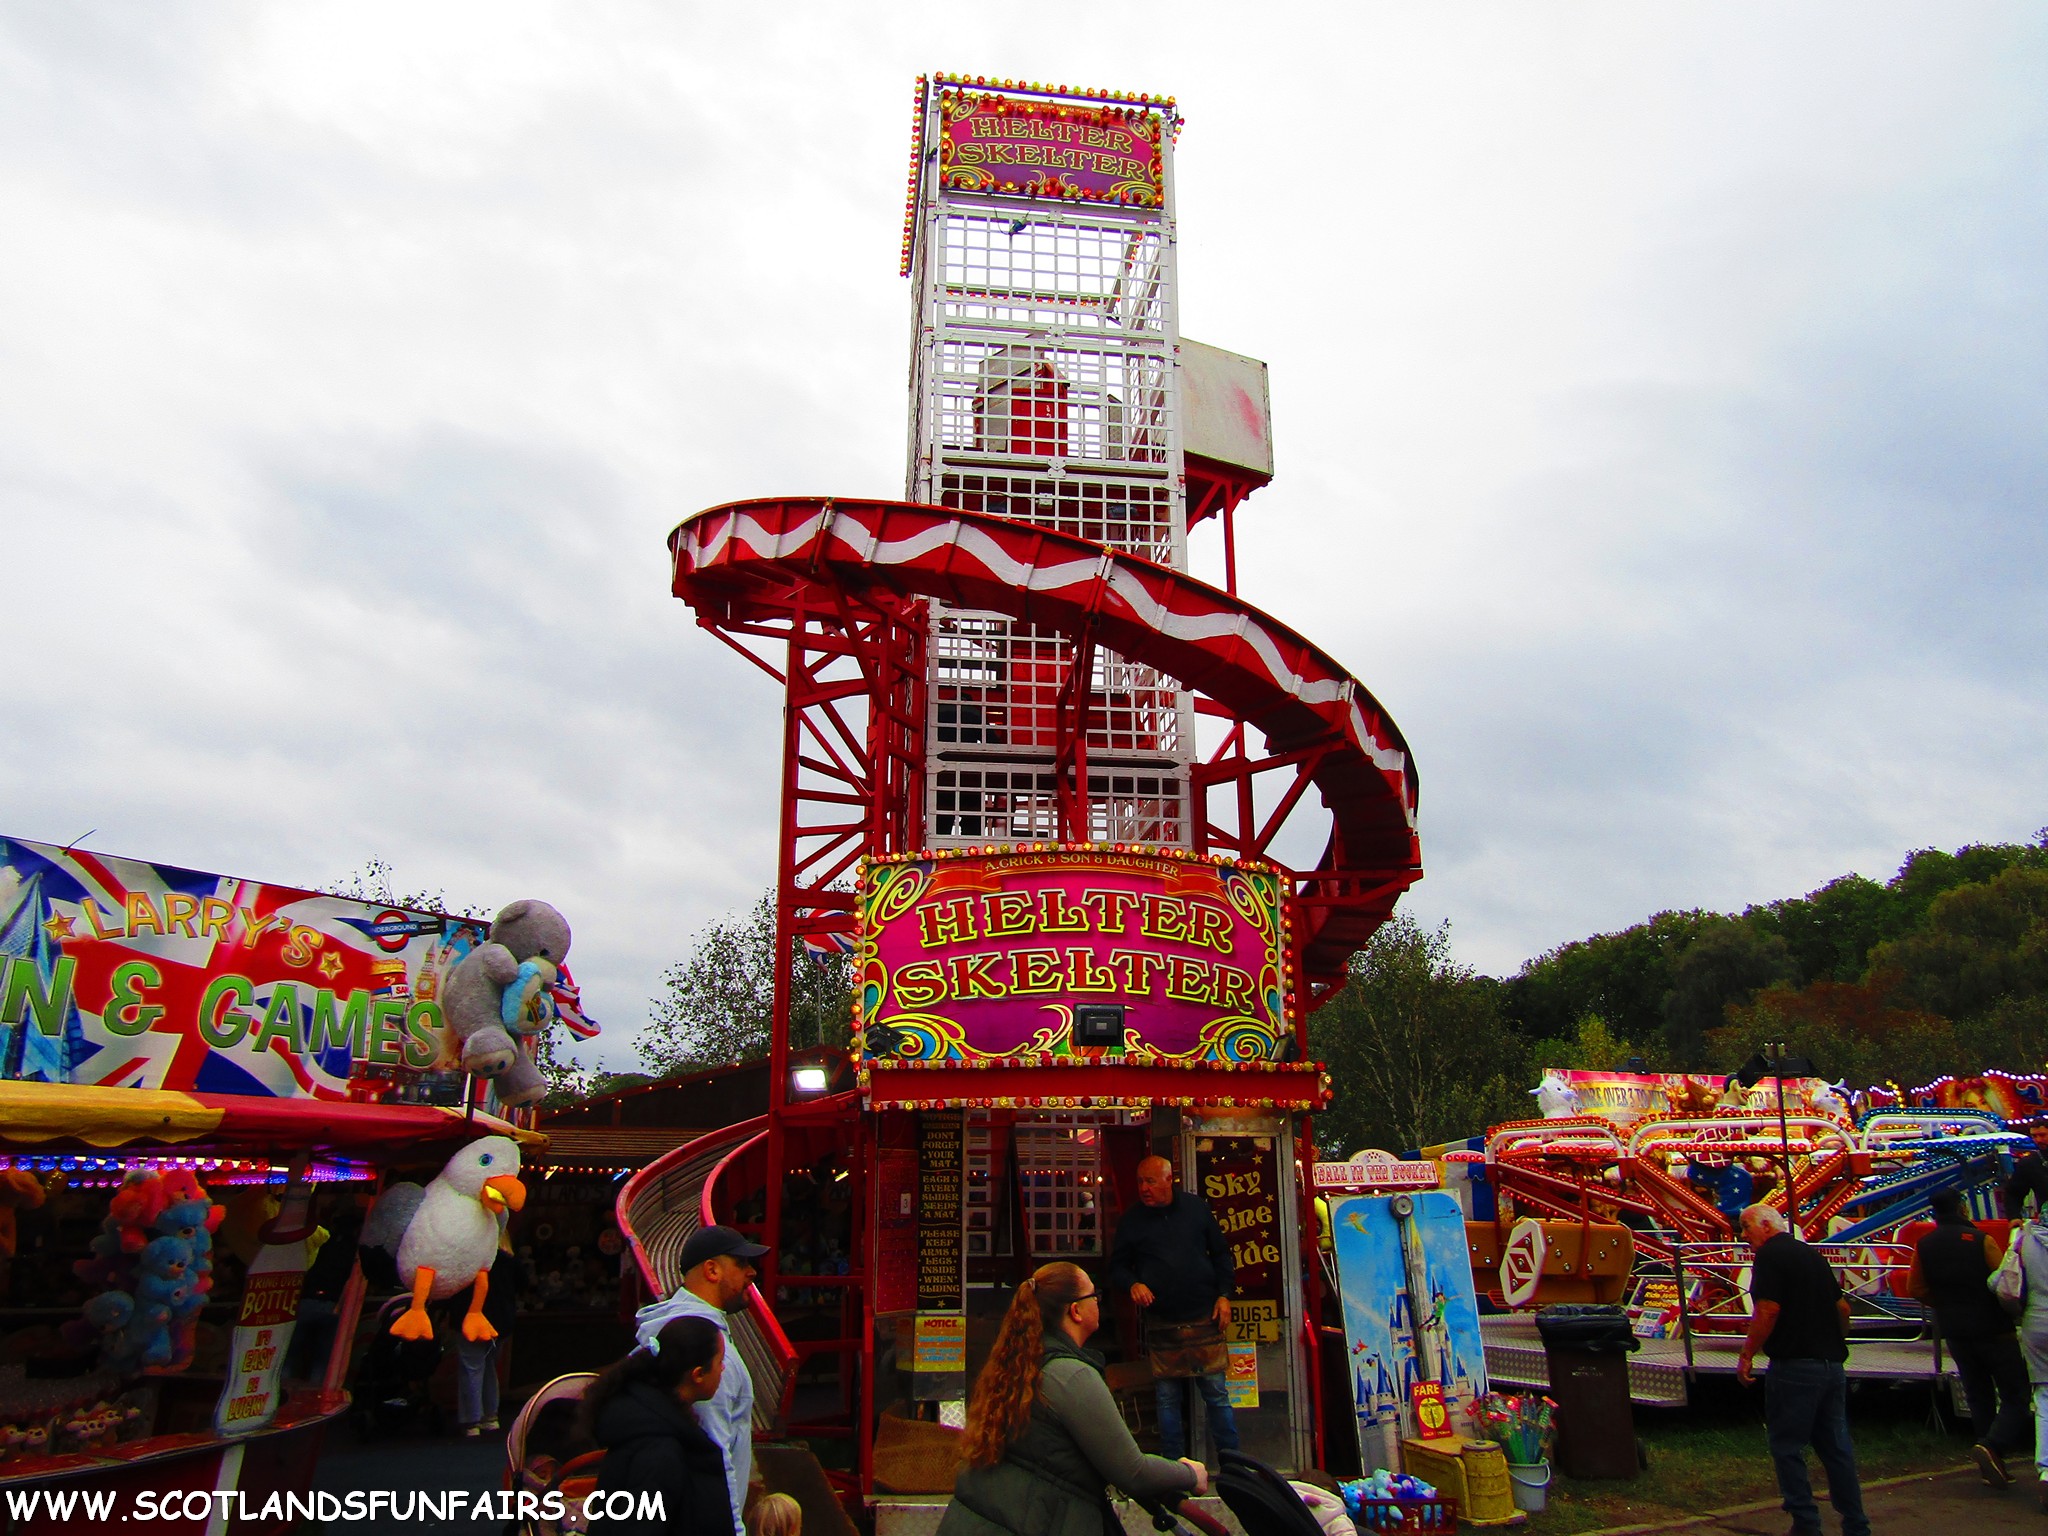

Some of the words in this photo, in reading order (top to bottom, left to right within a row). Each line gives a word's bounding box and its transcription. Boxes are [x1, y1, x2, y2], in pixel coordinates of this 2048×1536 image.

[969, 117, 1132, 153] HELTER
[957, 142, 1146, 181] SKELTER
[1048, 855, 1055, 864] &
[1060, 853, 1090, 864] SON
[1095, 855, 1101, 864] &
[1107, 855, 1178, 877] DAUGHTER
[916, 888, 1233, 954] HELTER
[82, 891, 323, 966] LARRY'S
[893, 947, 1255, 1014] SKELTER
[103, 962, 165, 1036] &
[199, 975, 445, 1068] GAMES
[1604, 1087, 1627, 1107] OVER
[922, 1141, 960, 1149] FORGET
[927, 1151, 954, 1159] YOUR
[923, 1175, 950, 1183] EACH
[1316, 1165, 1348, 1183] BALL
[1351, 1165, 1363, 1182] IN
[1367, 1164, 1388, 1181] THE
[1391, 1163, 1432, 1180] BUCKET
[924, 1184, 957, 1192] EVERY
[1204, 1170, 1262, 1198] Sky
[922, 1193, 959, 1201] SLIDER
[923, 1202, 957, 1210] NEEDS
[924, 1210, 931, 1218] A
[934, 1210, 955, 1218] MAT
[926, 1239, 954, 1247] KEEP
[920, 1248, 949, 1256] ARMS
[925, 1257, 953, 1265] LEGS
[922, 1266, 956, 1274] INSIDE
[255, 1276, 278, 1288] RING
[281, 1274, 305, 1287] OVER
[924, 1275, 953, 1283] WHEN
[920, 1284, 960, 1293] SLIDING
[241, 1289, 301, 1320] BOTTLE
[256, 1315, 264, 1324] TO
[266, 1314, 281, 1323] WIN
[1231, 1306, 1272, 1322] BU63
[924, 1319, 957, 1327] NOTICE
[1236, 1323, 1267, 1339] ZFL
[242, 1347, 276, 1373] EASY
[246, 1377, 259, 1393] BE
[1414, 1384, 1440, 1397] FARE
